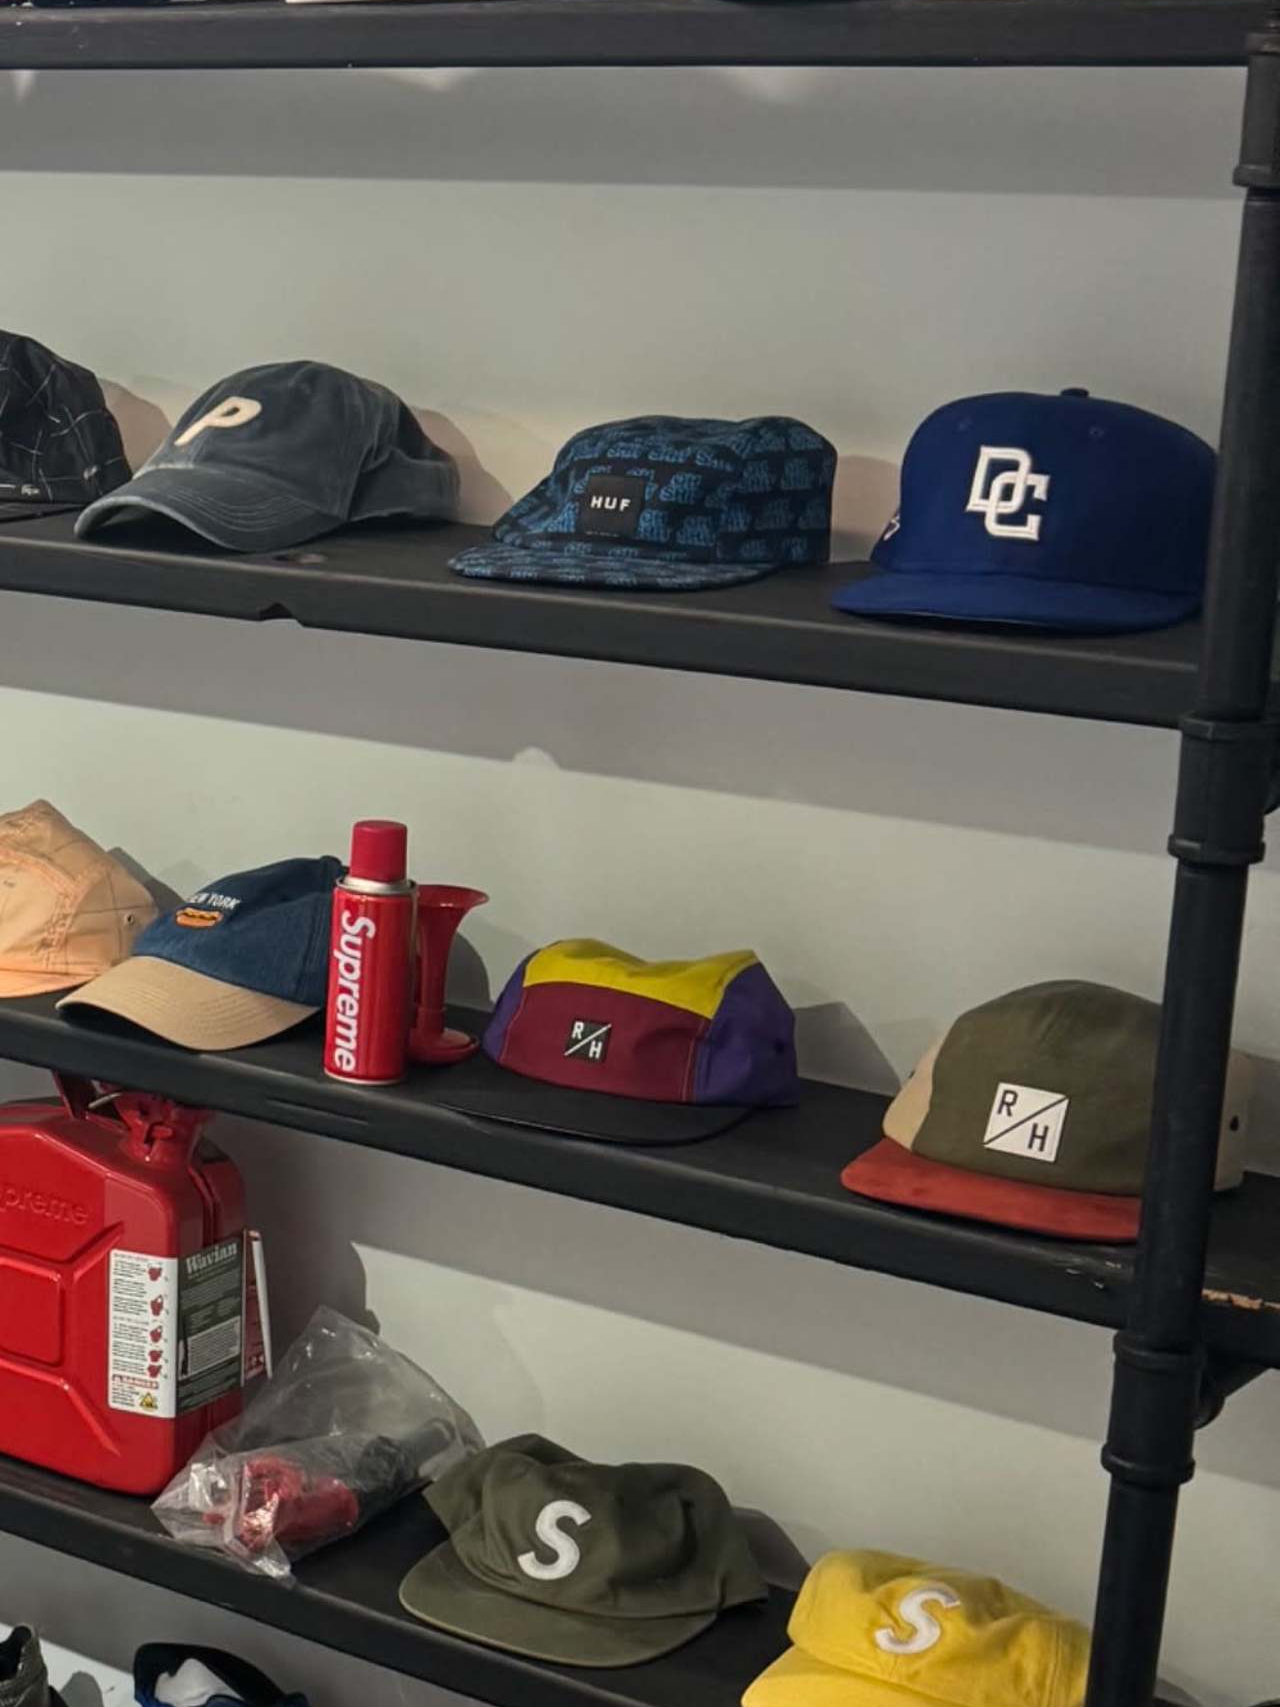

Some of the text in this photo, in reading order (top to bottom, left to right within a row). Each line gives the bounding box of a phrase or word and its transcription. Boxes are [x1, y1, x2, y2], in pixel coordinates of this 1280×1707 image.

[173, 396, 263, 449] P
[591, 496, 632, 522] HUF
[333, 910, 376, 1073] Supreme
[517, 1499, 592, 1581] S
[874, 1582, 961, 1656] S
